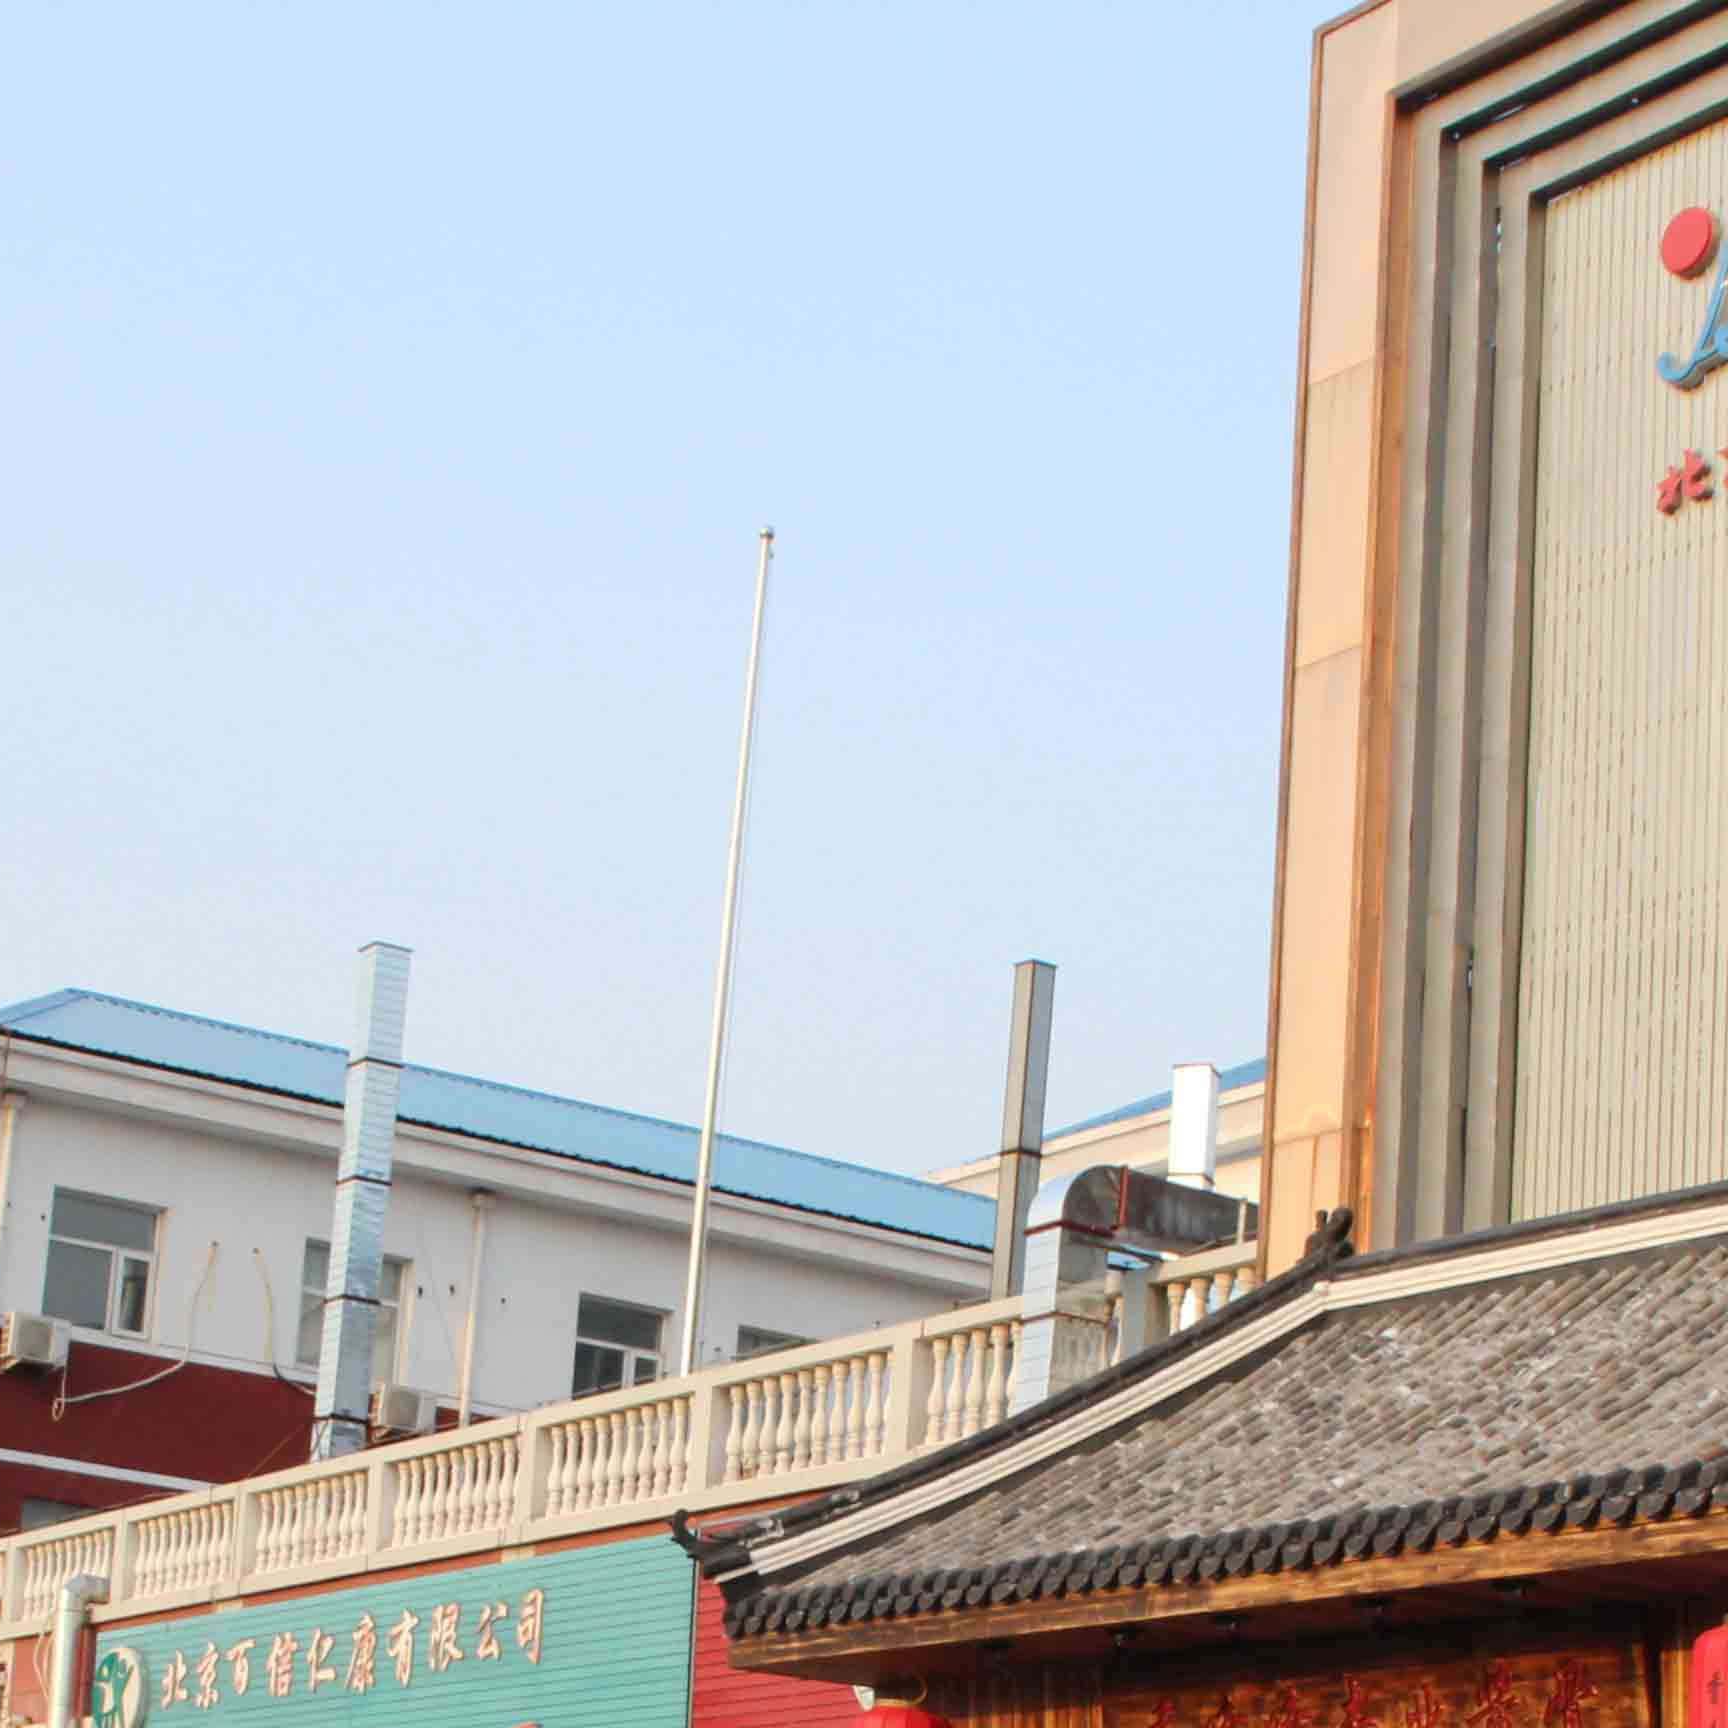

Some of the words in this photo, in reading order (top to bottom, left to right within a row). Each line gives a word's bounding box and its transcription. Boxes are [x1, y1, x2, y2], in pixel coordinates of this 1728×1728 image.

[159, 1587, 545, 1709] 北京百信仁康有限公司
